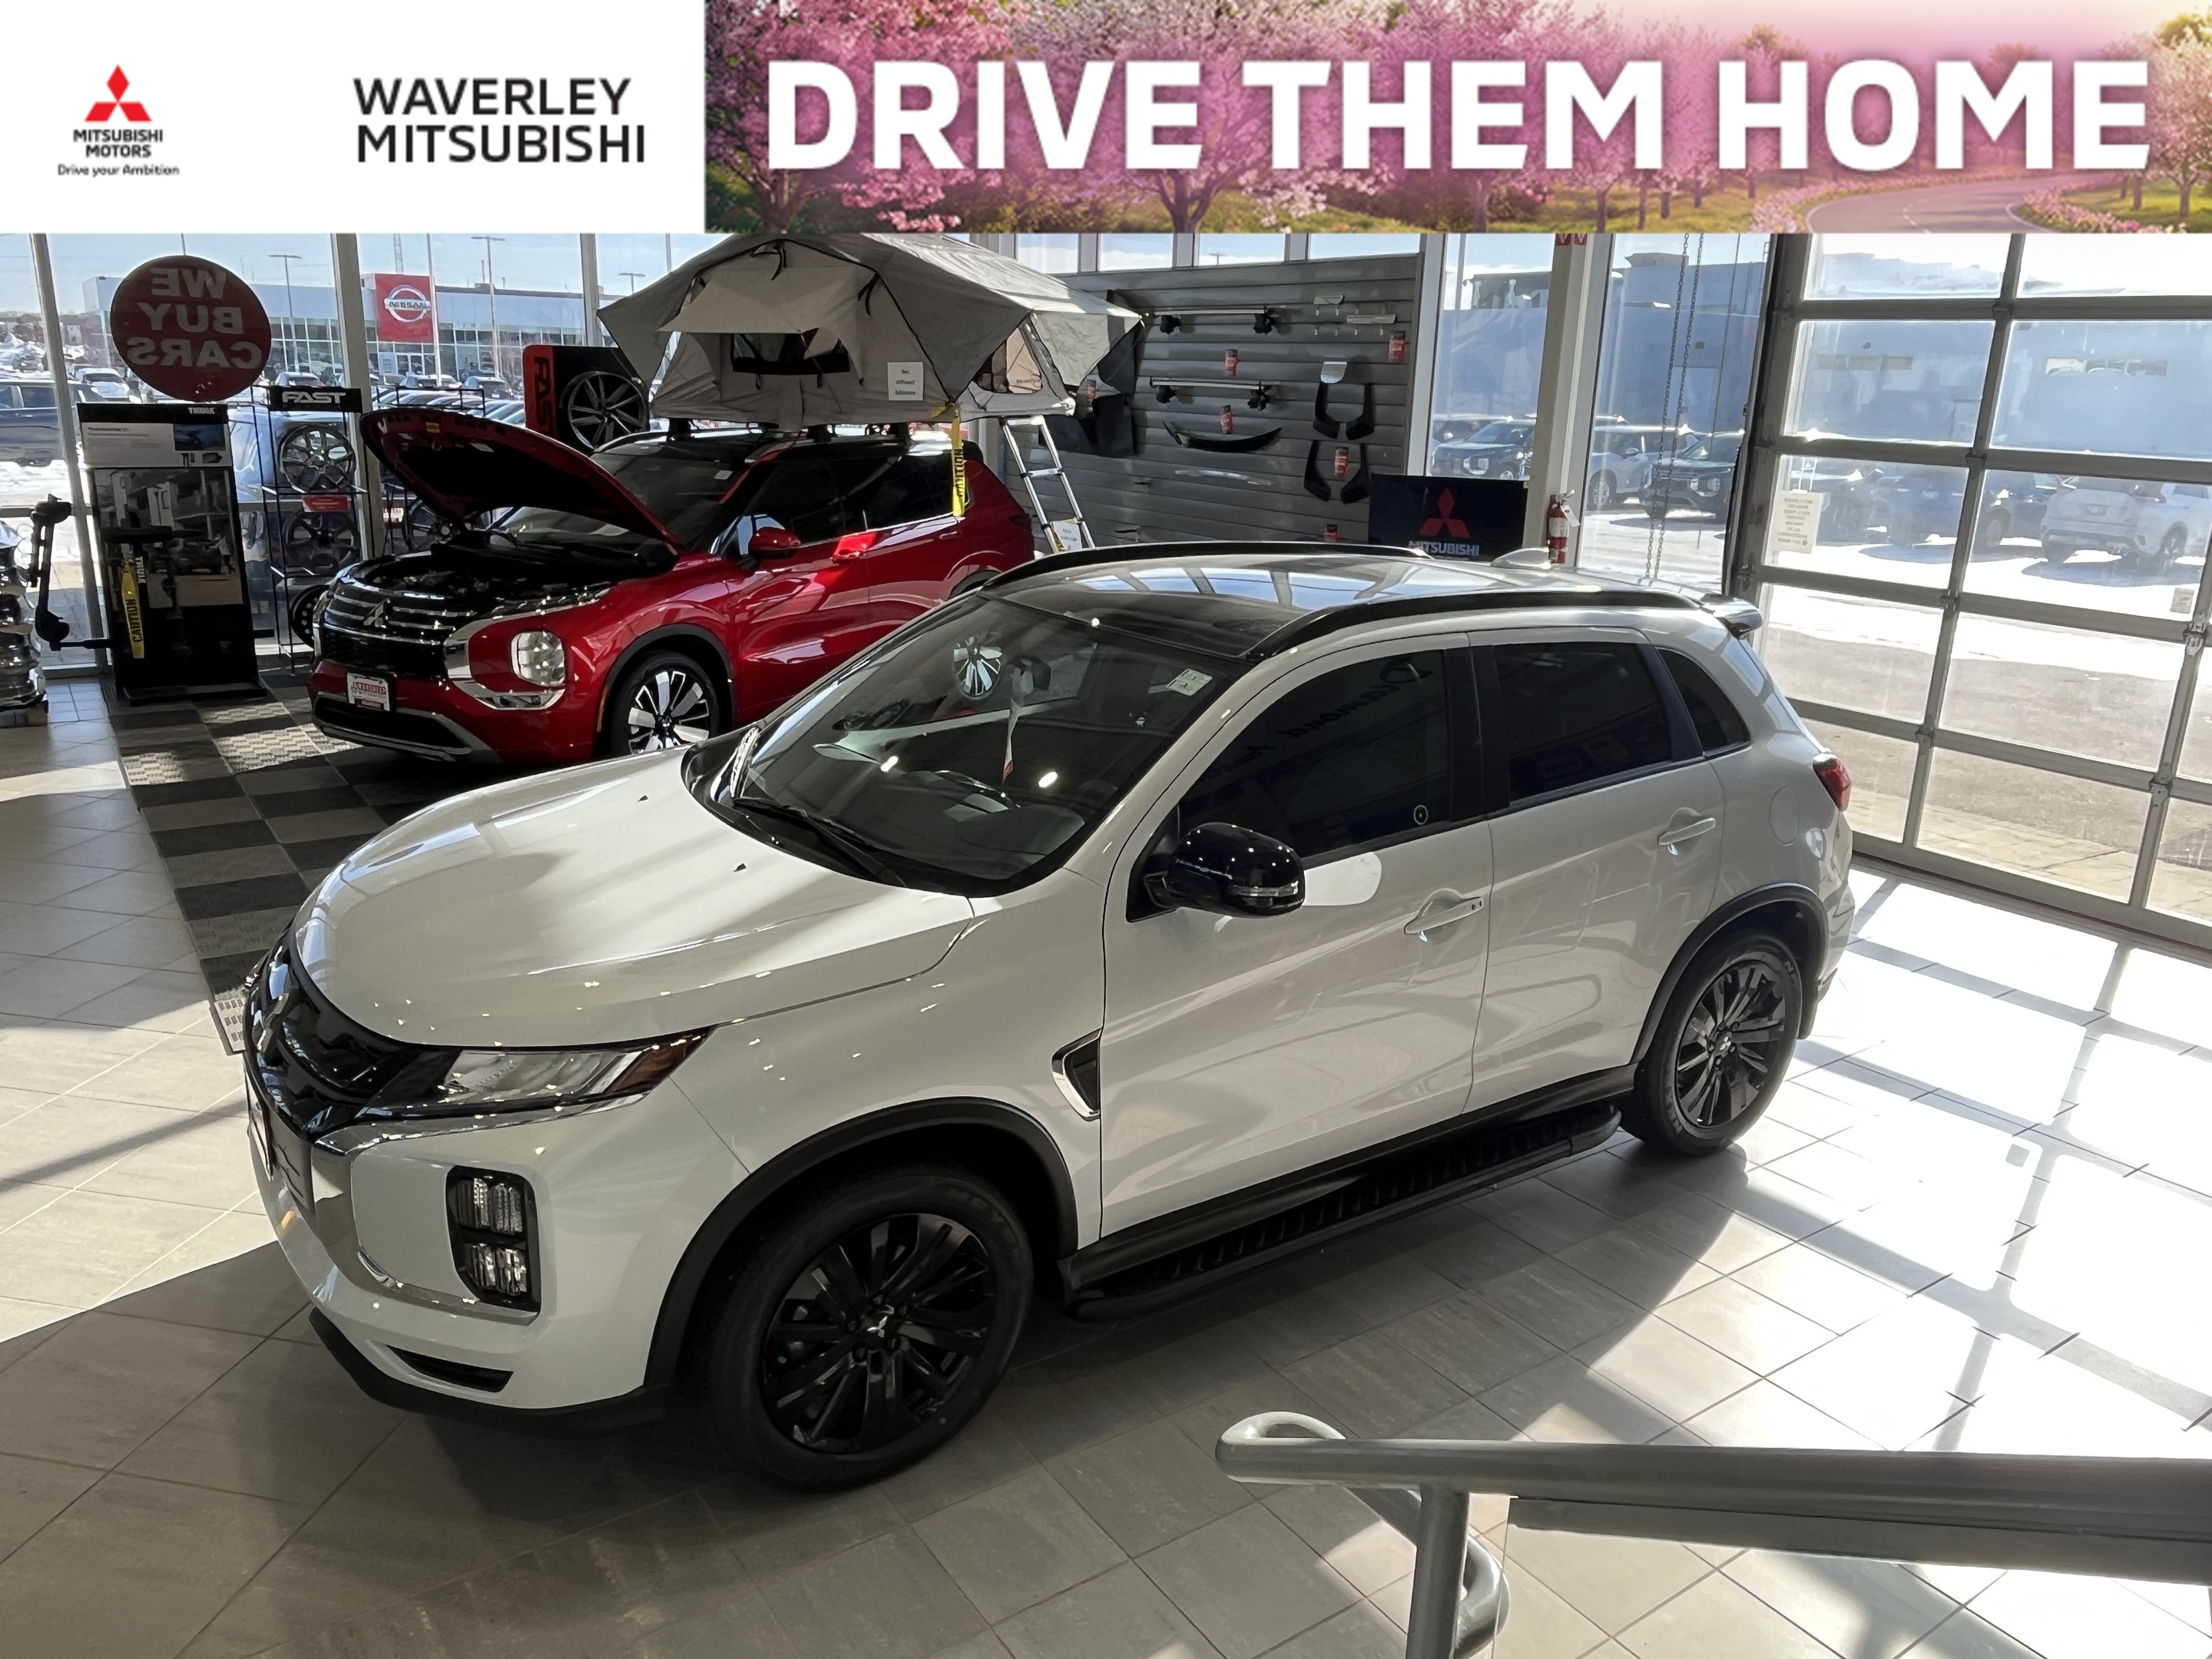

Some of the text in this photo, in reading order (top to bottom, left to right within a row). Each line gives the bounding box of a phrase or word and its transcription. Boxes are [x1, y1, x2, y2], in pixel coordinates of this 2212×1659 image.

[282, 391, 346, 403] FAST
[534, 356, 556, 436] FAS
[125, 598, 143, 643] CAUTION
